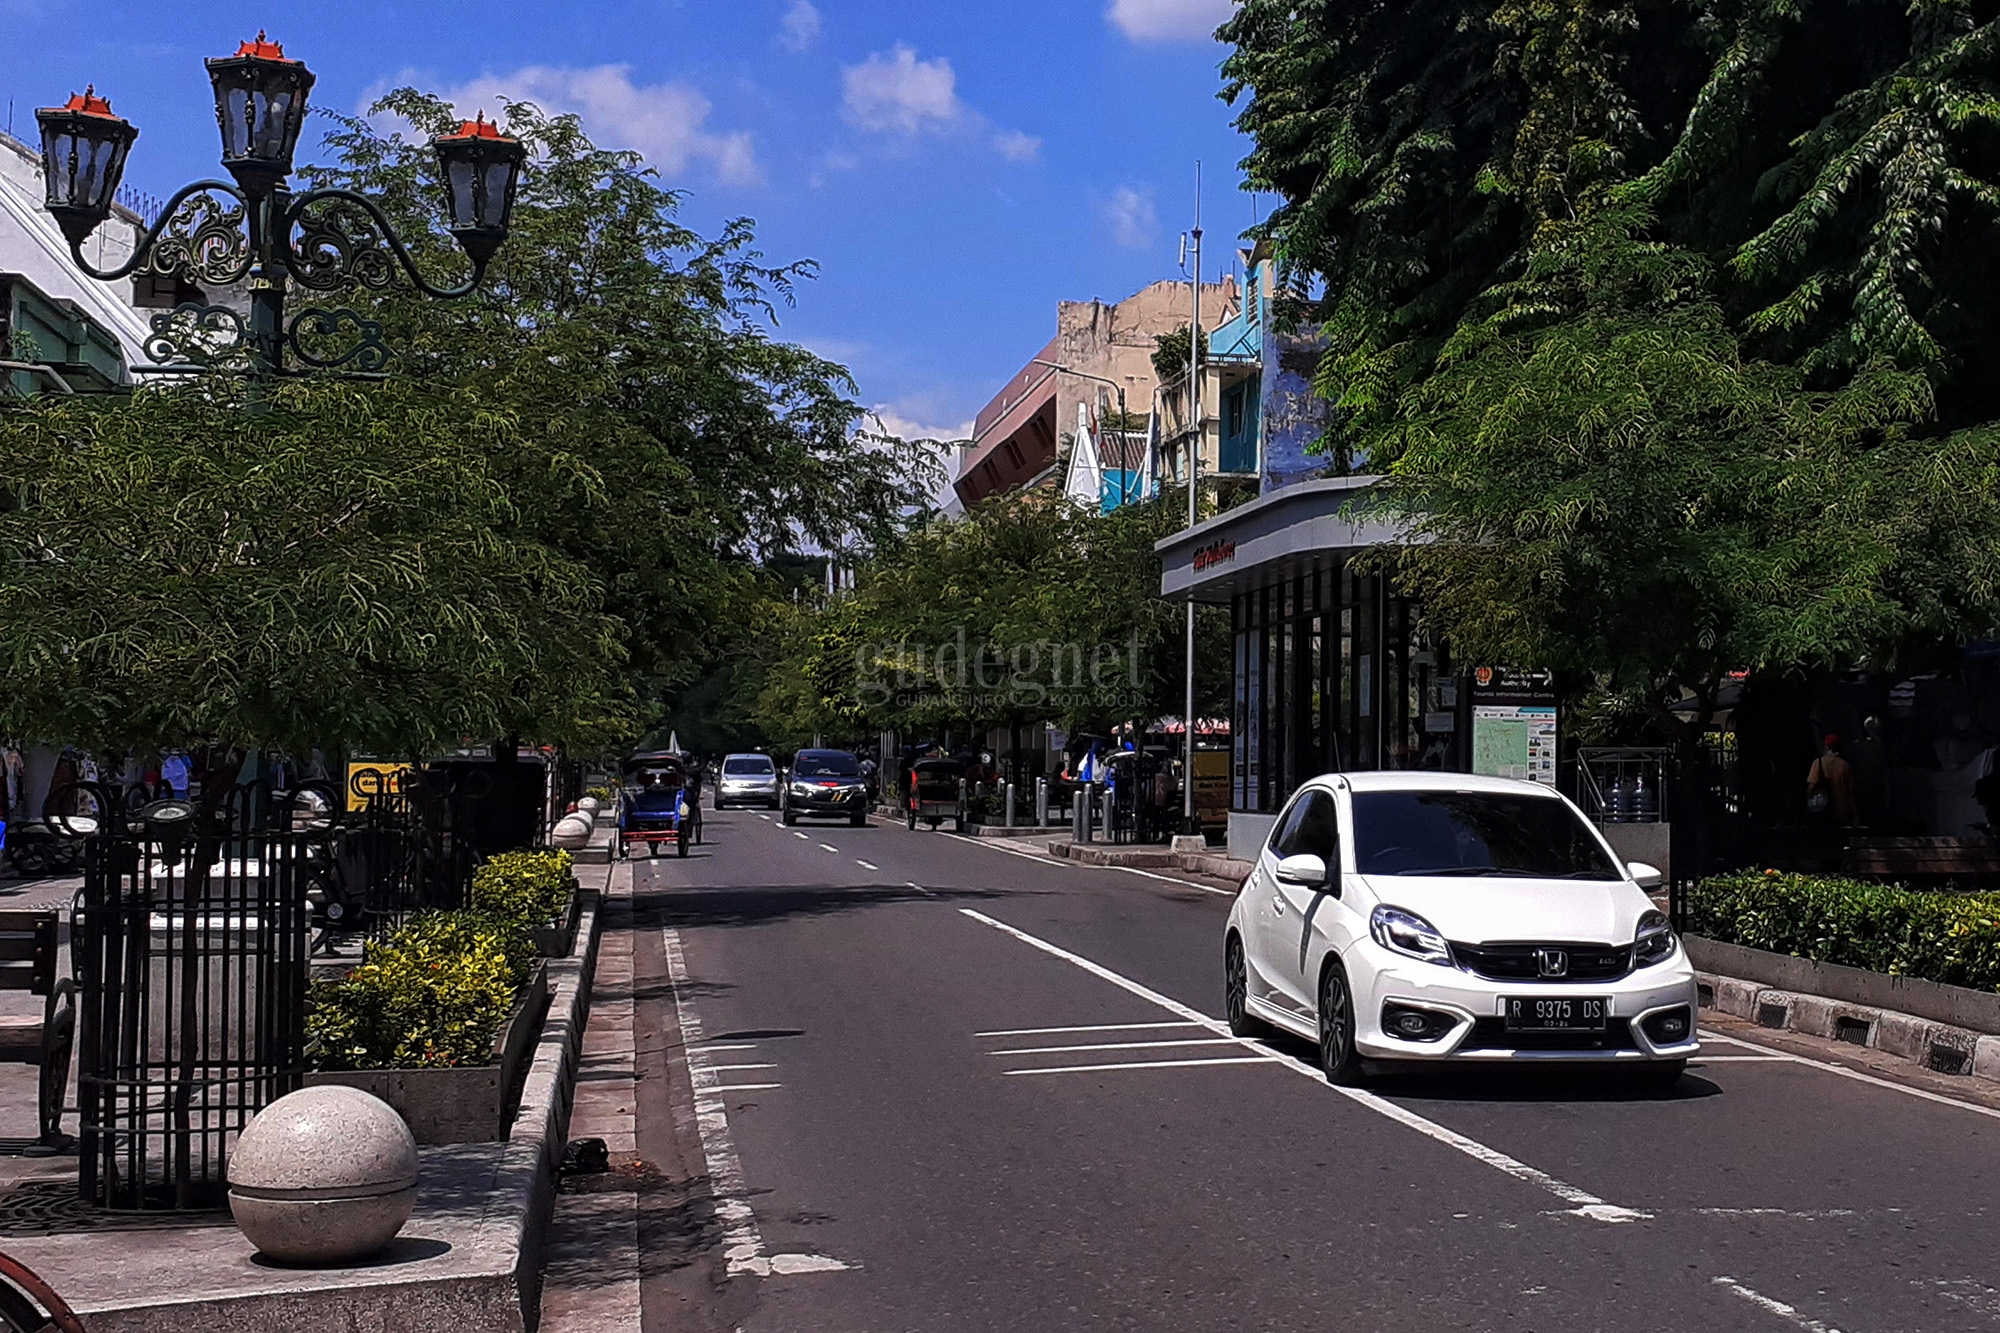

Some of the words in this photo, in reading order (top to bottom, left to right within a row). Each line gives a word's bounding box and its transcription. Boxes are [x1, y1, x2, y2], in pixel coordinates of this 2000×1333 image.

[1513, 1000, 1521, 1018] R
[1536, 1000, 1571, 1018] 9375
[1583, 1000, 1601, 1018] DS
